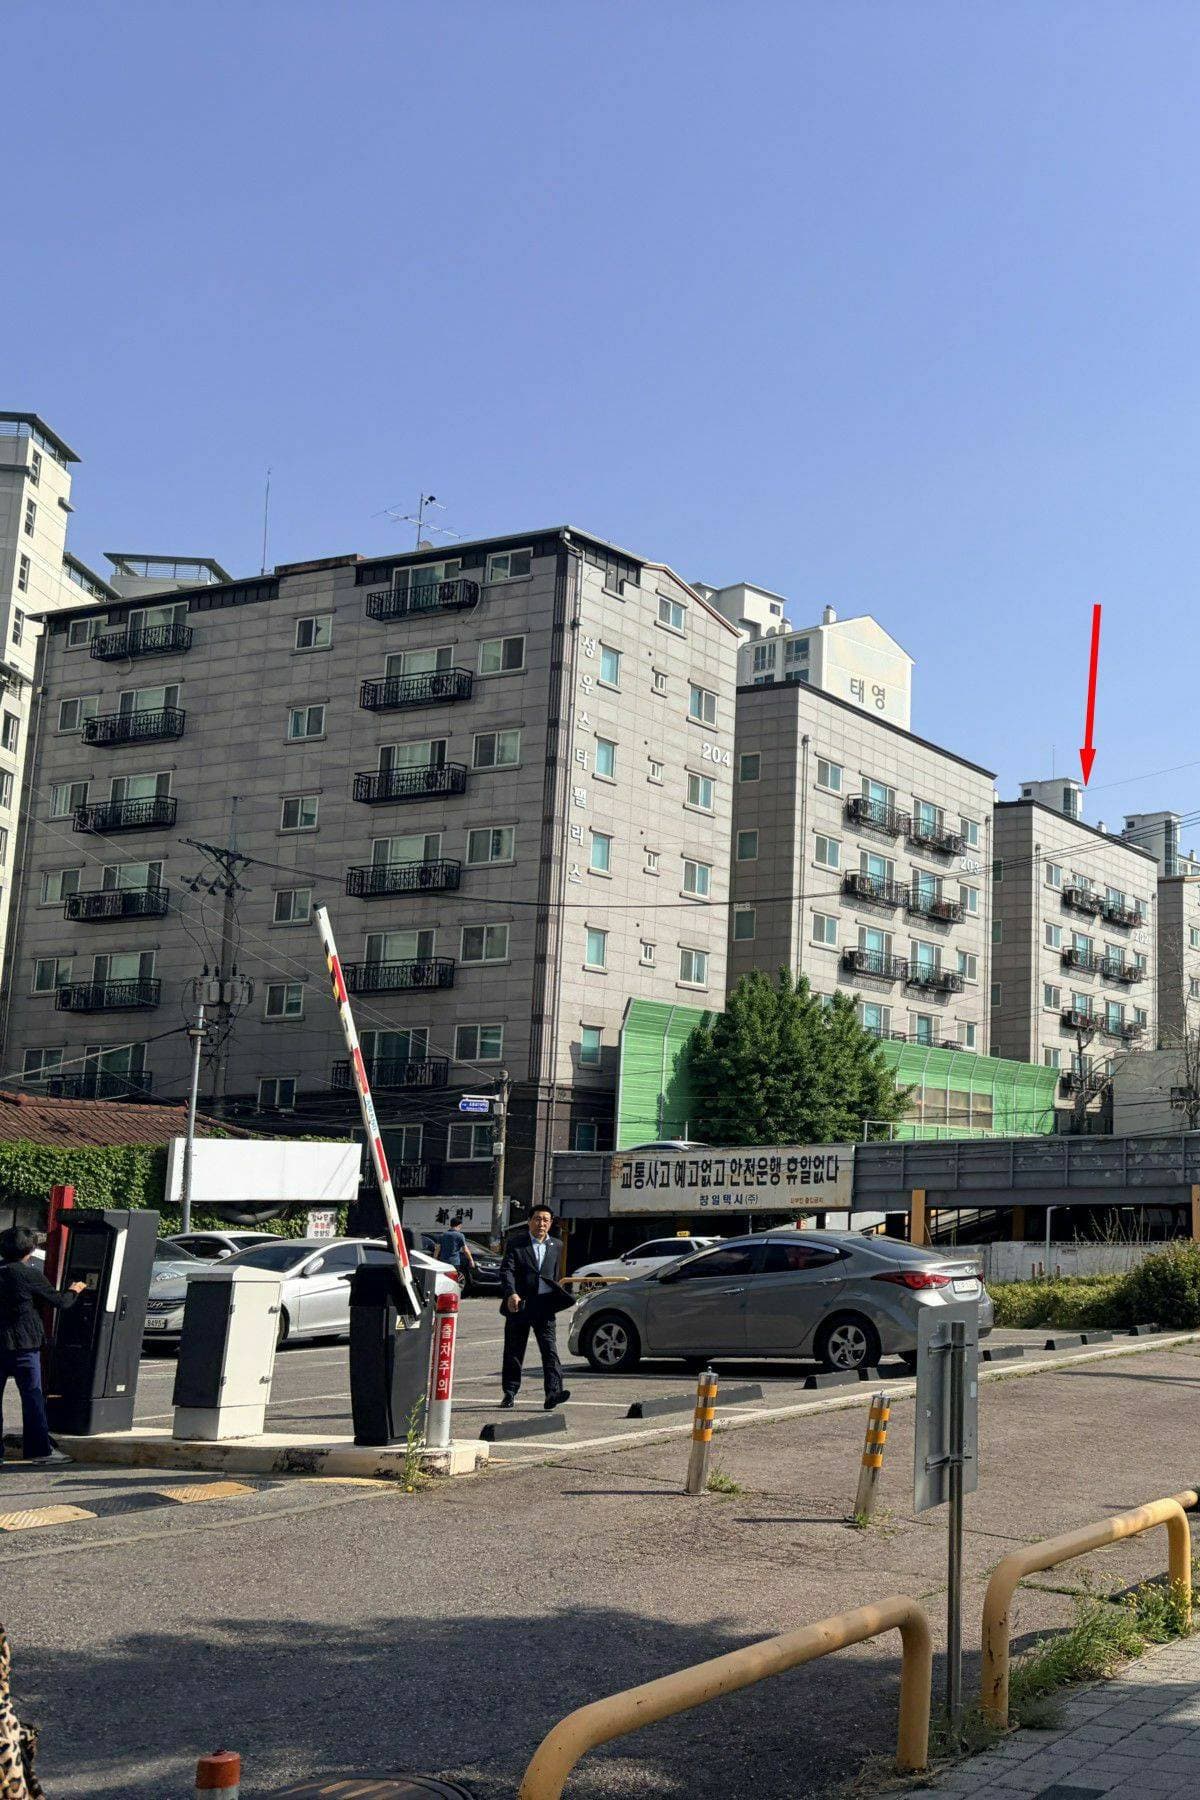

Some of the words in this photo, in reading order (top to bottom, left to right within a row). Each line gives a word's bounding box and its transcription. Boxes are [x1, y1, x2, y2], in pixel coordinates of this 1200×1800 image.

[850, 676, 887, 710] 태영
[568, 635, 596, 884] 성우스타팰리스
[702, 742, 732, 768] 204
[621, 1161, 670, 1189] 교통사고
[674, 1158, 725, 1188] 예고없고
[730, 1156, 781, 1187] 안전운행
[786, 1154, 839, 1185] 휴일없다
[437, 1323, 452, 1394] 출차주의
